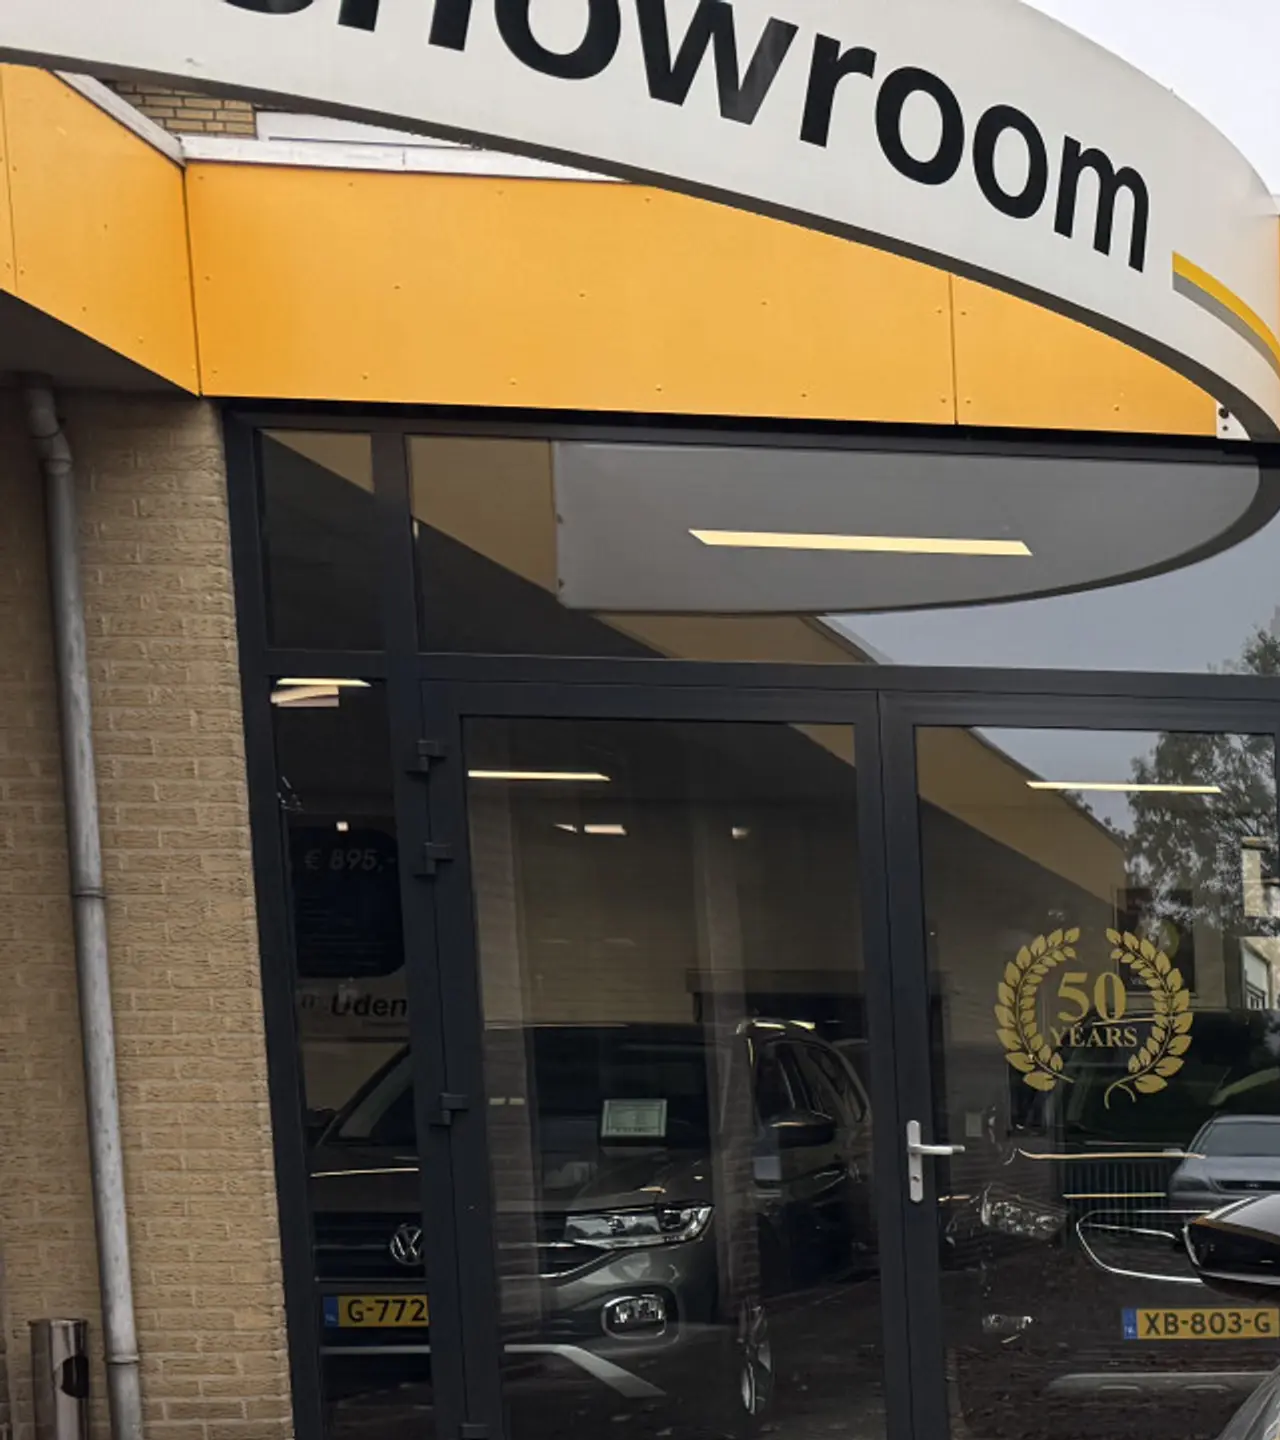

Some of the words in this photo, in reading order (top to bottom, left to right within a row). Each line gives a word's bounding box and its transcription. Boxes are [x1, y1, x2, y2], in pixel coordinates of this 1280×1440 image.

[1057, 972, 1126, 1022] 50
[1050, 1026, 1137, 1047] YEARS
[348, 1299, 426, 1322] G-772
[1143, 1312, 1271, 1335] XB-803-G
